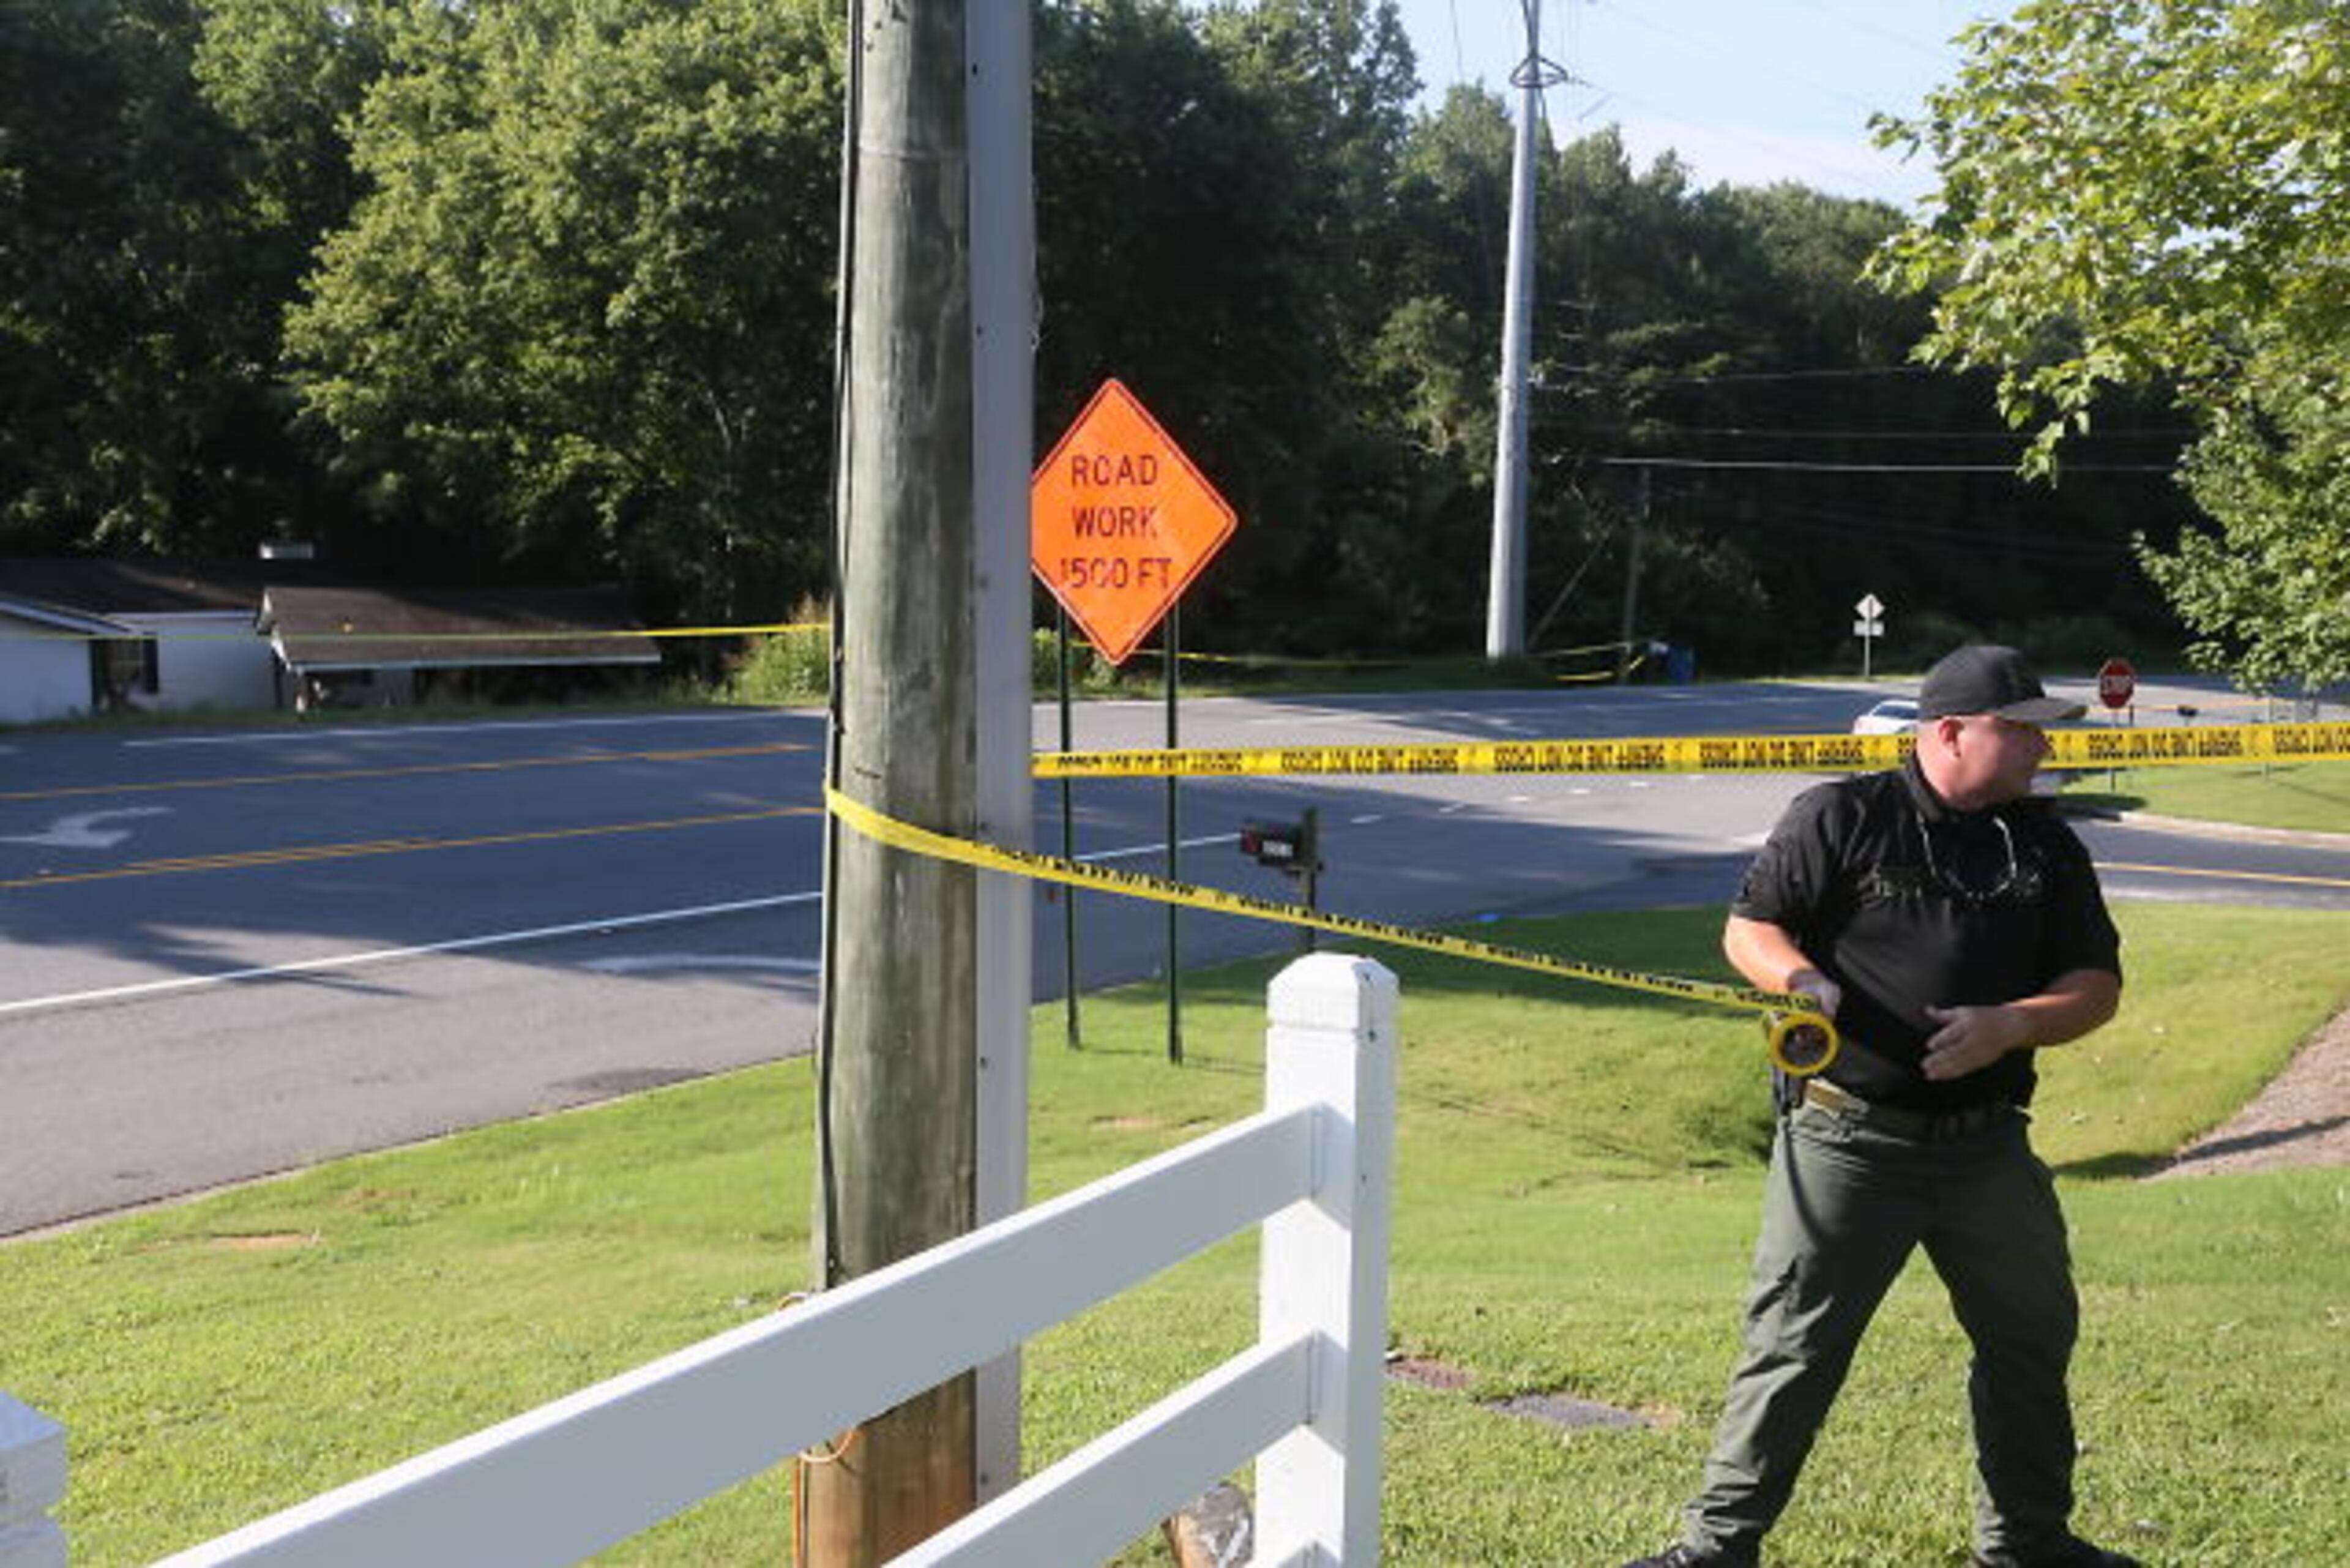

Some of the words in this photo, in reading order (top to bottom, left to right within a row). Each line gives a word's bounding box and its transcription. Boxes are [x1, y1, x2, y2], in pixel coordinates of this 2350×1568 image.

[1071, 455, 1158, 487] ROAD
[1071, 507, 1158, 539] WORK
[1060, 558, 1128, 589] 1500
[1138, 558, 1172, 588] FT
